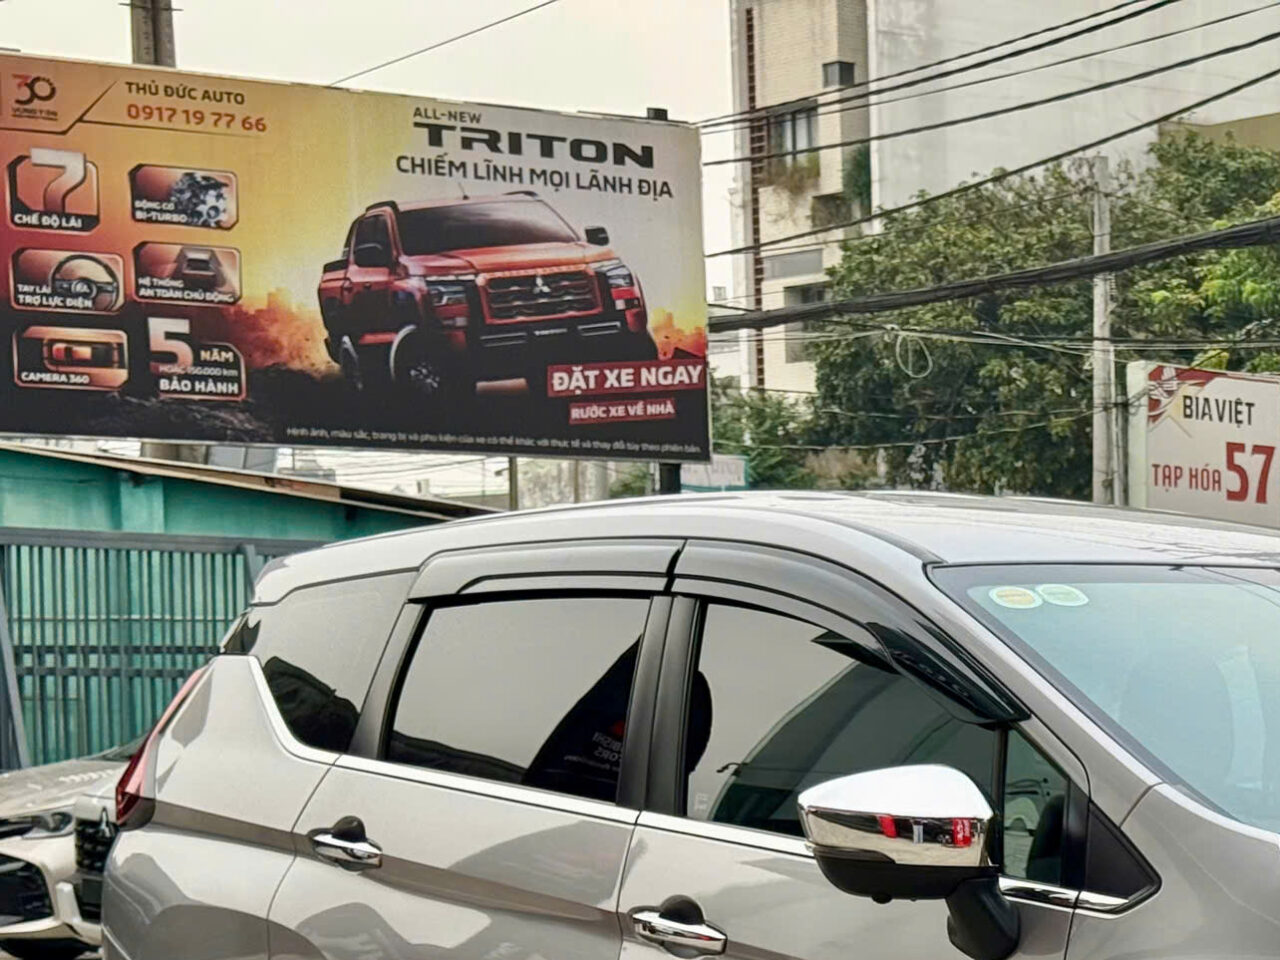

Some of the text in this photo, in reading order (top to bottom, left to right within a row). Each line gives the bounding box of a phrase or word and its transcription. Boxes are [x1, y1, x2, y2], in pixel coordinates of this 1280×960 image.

[124, 80, 246, 105] THỦ ĐỨC AUTO
[127, 103, 267, 133] 0917 19 77 66
[413, 106, 482, 125] ALL-NEW
[413, 121, 655, 169] TRITON
[30, 148, 87, 213] 7
[396, 152, 674, 201] CHIẾM LĨNH MỌI LÃNH ĐỊA
[14, 212, 40, 225] CHẾ
[41, 215, 60, 229] ĐỘ
[147, 317, 194, 375] 5
[200, 347, 234, 362] NĂM
[21, 372, 90, 384] CAMERA 360
[159, 375, 239, 394] BẢO HÀNH
[552, 365, 703, 395] ĐẶT XE NGAY
[609, 405, 626, 418] XE
[647, 399, 675, 415] NHÀ
[1183, 395, 1256, 428] BIA VIỆT
[1152, 441, 1276, 504] TẠP HÓA 57
